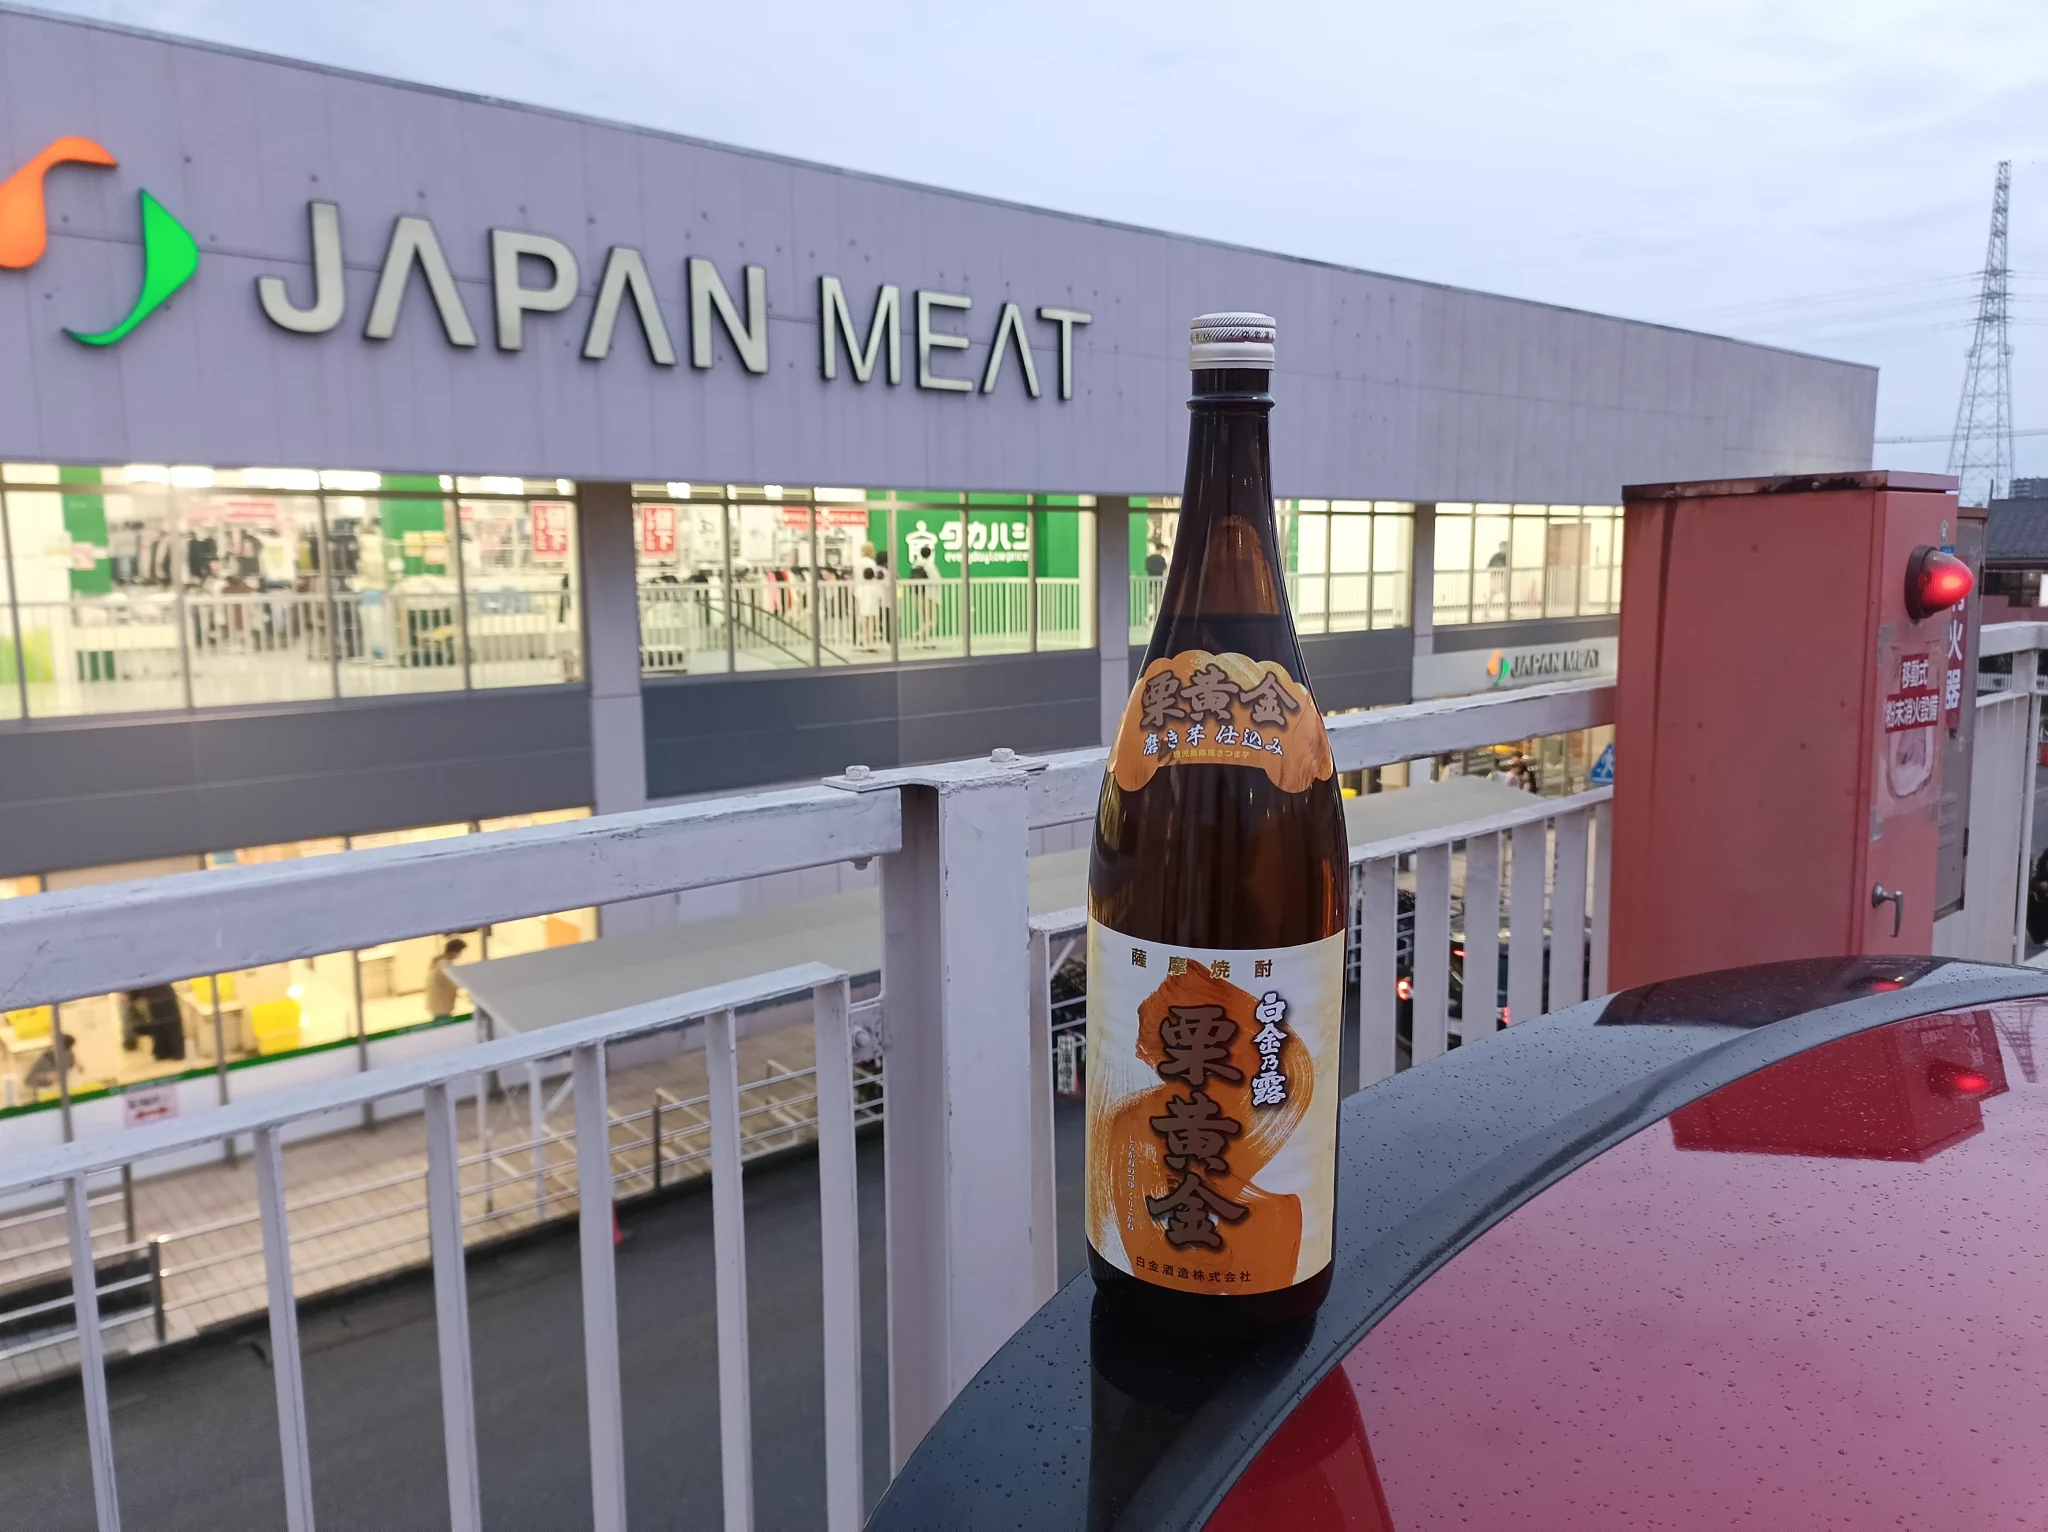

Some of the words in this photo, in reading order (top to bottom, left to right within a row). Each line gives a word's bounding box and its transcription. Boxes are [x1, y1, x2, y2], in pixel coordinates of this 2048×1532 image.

[255, 198, 769, 373] JAPAN
[817, 274, 1093, 401] MEAT
[939, 521, 1029, 550] タカハシ
[1141, 664, 1299, 727] 栗黄金
[1902, 658, 1929, 688] 移動式
[1945, 598, 1966, 711] 火器
[1252, 993, 1288, 1106] 白金乃露
[1145, 1004, 1250, 1249] 栗黄金
[1136, 1256, 1251, 1283] 白金酒造株式会社
